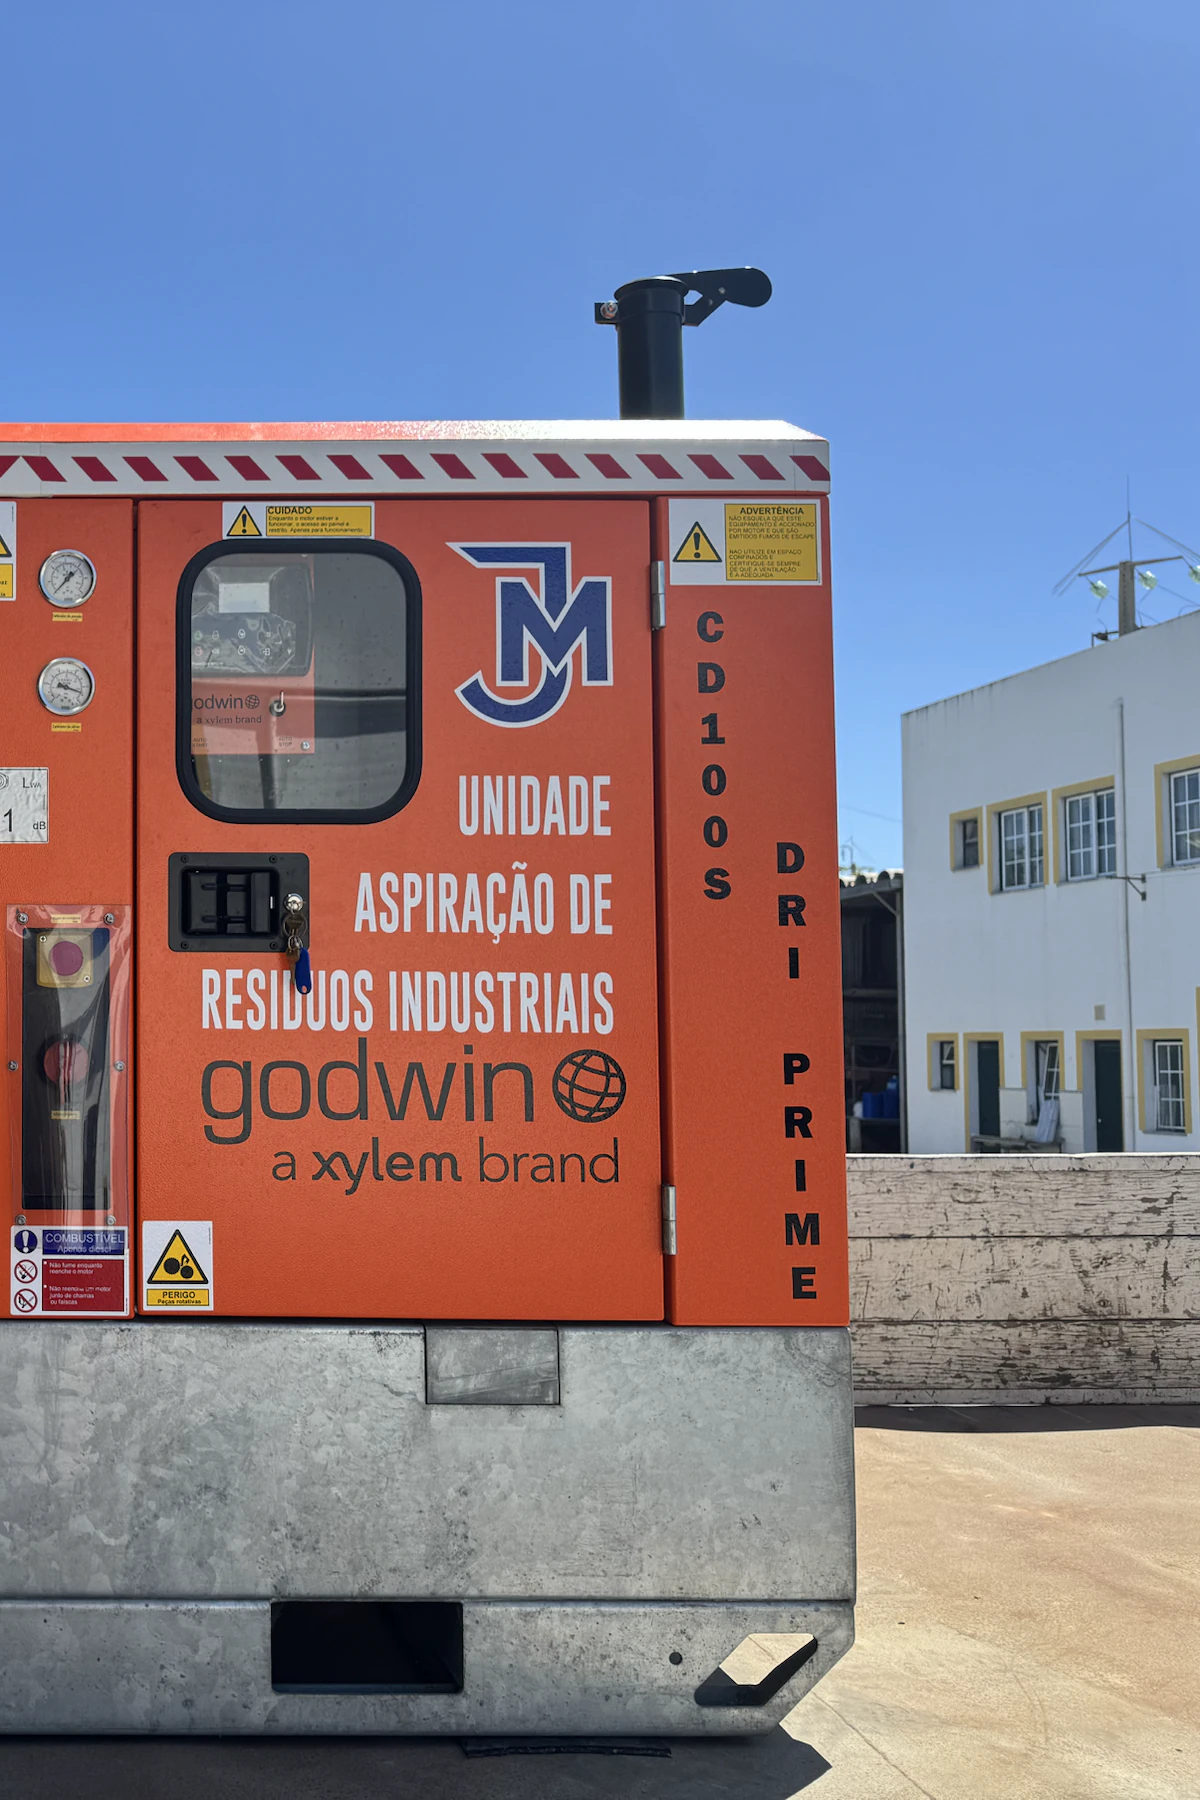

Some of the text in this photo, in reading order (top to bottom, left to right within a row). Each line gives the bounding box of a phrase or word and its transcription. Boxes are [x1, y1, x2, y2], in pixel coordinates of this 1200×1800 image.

[268, 506, 312, 514] CUIDADO
[740, 506, 804, 514] ADVERTÊNCIA
[194, 694, 243, 709] odwin
[205, 716, 232, 725] xylem
[236, 715, 262, 724] brand
[458, 775, 612, 836] UNIDADE
[33, 821, 46, 830] dB
[354, 861, 614, 945] ASPIRAÇÃO DE
[202, 968, 614, 1034] RESIDUOS INDUSTRIAIS
[202, 1037, 534, 1144] godwin
[271, 1137, 619, 1195] a xylem brand
[45, 1232, 124, 1243] COMBUSTÍVEL
[57, 1245, 111, 1254] Apenas diesel
[163, 1291, 195, 1299] PERIGO
